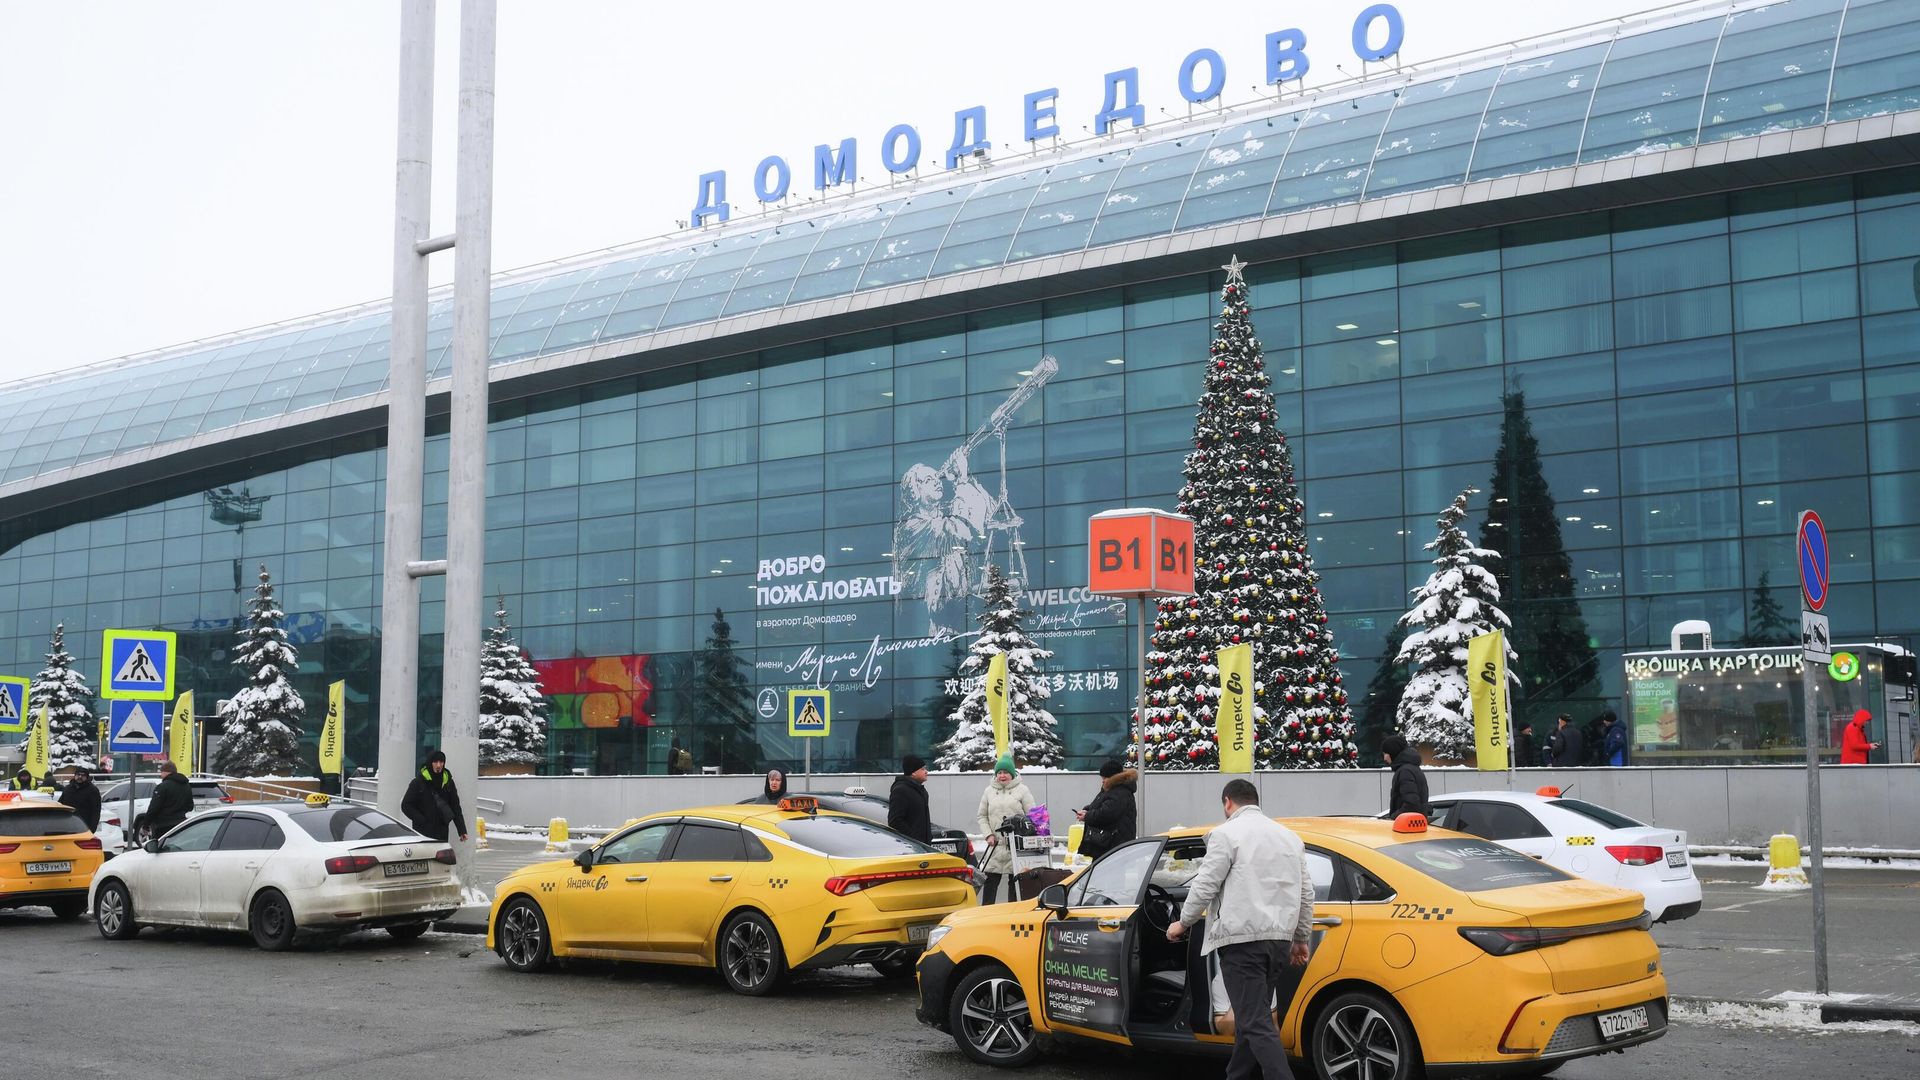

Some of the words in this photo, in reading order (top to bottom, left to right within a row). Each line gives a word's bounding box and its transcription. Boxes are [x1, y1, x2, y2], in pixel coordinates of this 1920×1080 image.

[691, 3, 1405, 227] ДОМОДЕДОВО
[757, 555, 826, 581] ДОБРО
[756, 576, 903, 606] ПОЖАЛОВАТЬ
[1027, 586, 1123, 607] WELCO
[756, 620, 762, 628] в
[763, 617, 802, 629] аэропорт
[803, 613, 857, 626] Домодедово
[1029, 629, 1072, 639] Domodedovo
[1073, 628, 1096, 638] Airport
[756, 660, 783, 669] имени
[1481, 662, 1497, 686] Go
[1624, 656, 1704, 674] КРОШКА
[1709, 652, 1804, 671] КАРТОШК
[1226, 672, 1244, 695] Go
[1233, 697, 1244, 751] Яндекс
[1490, 688, 1501, 747] Яндекс
[324, 719, 336, 757] Яндекс
[566, 877, 596, 889] Яндекс
[595, 875, 609, 891] Go
[1391, 903, 1419, 919] 722
[1059, 930, 1089, 945] MELKE
[1045, 959, 1071, 976] ОКНА
[1072, 963, 1108, 982] MELKE
